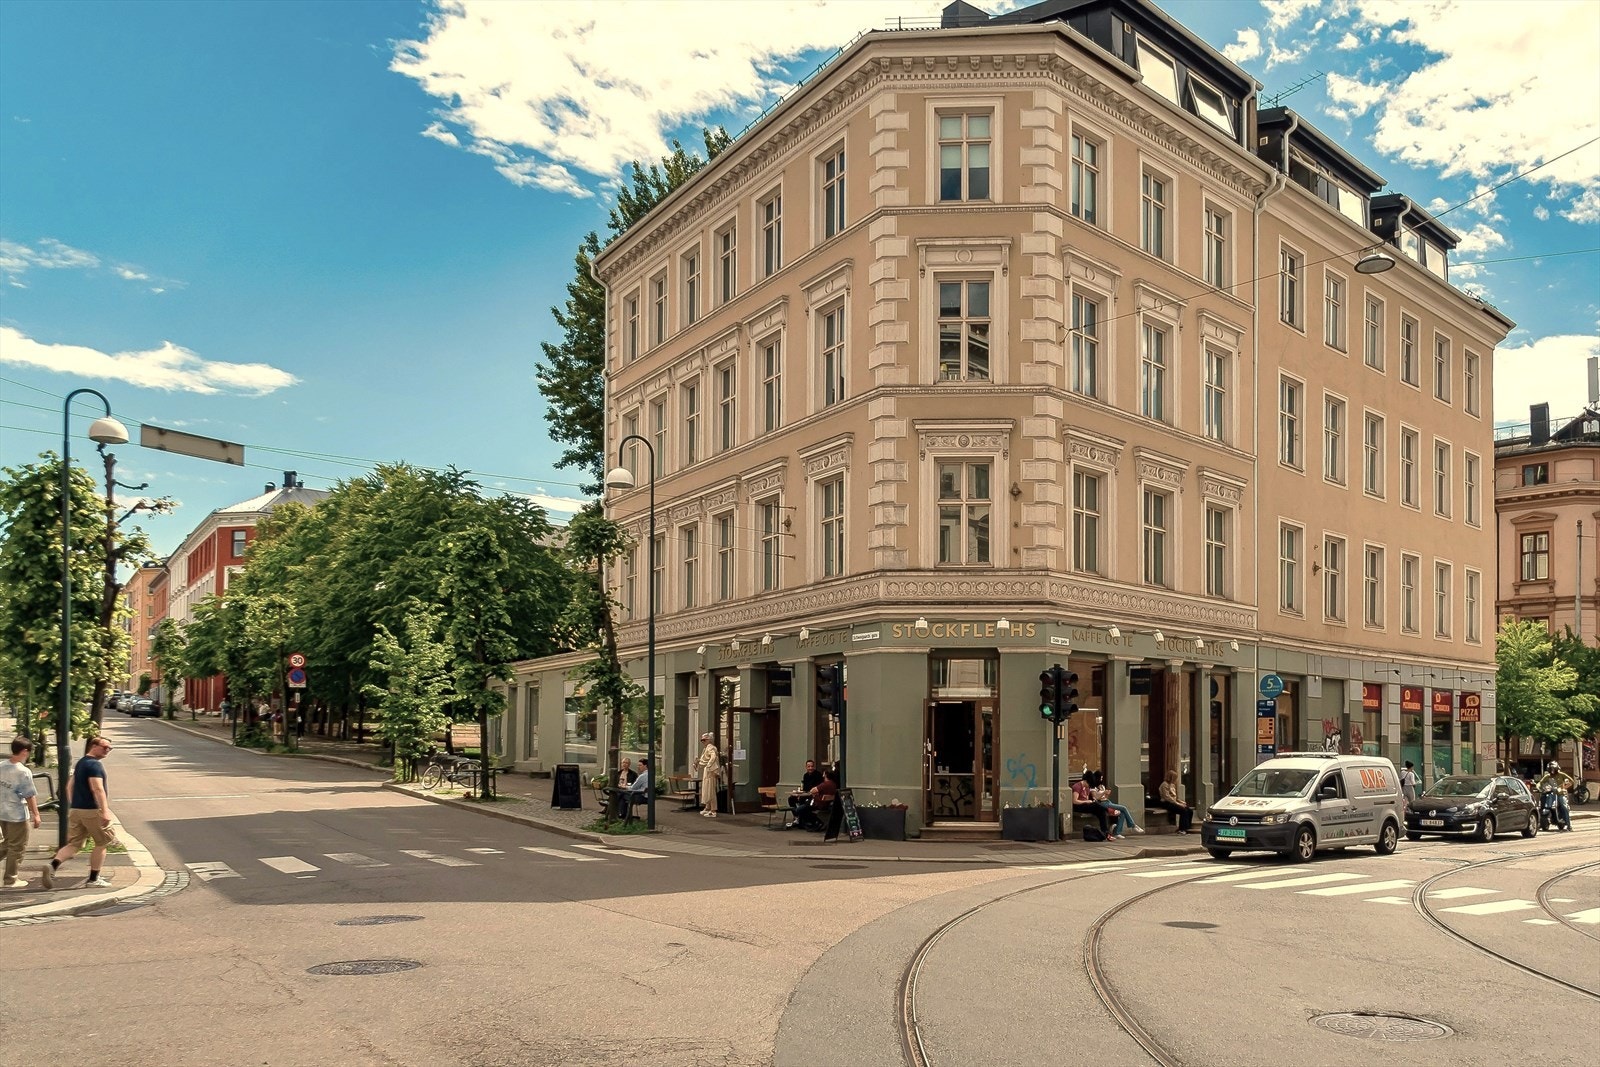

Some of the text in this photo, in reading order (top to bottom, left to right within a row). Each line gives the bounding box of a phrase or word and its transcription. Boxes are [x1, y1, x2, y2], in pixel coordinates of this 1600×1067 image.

[823, 633, 835, 646] OG
[838, 631, 848, 643] TE
[1072, 628, 1133, 647] KAFFE OG TE
[292, 656, 303, 665] 30
[1266, 678, 1274, 689] 5
[1460, 708, 1479, 716] PIZZA
